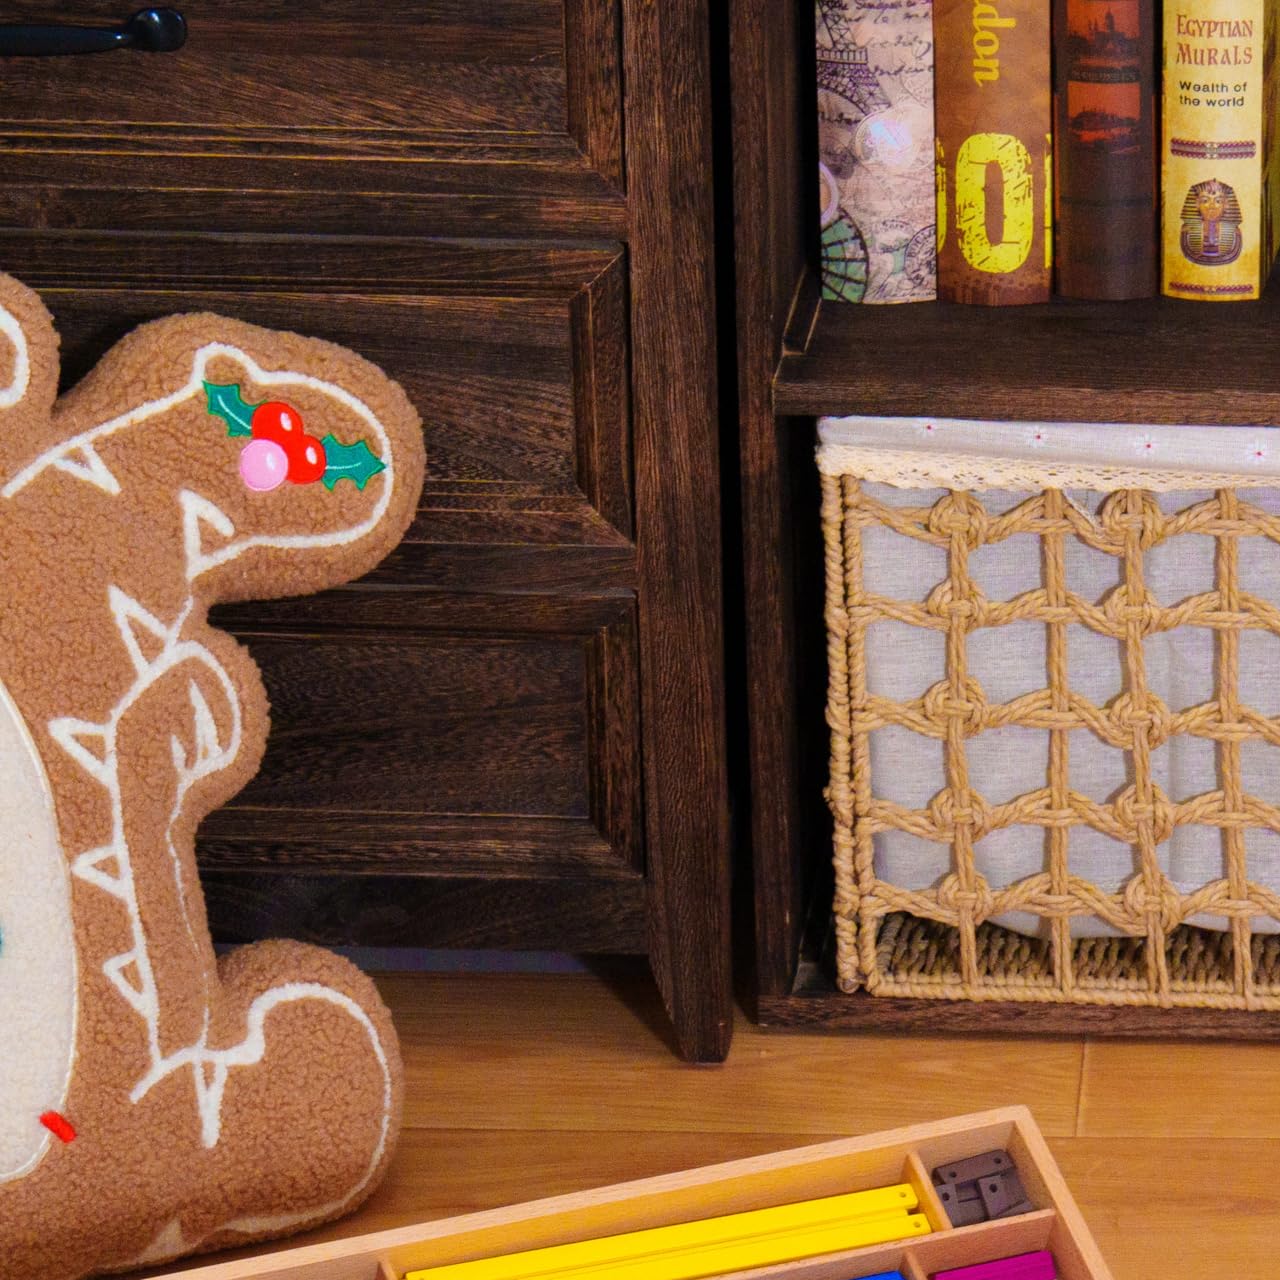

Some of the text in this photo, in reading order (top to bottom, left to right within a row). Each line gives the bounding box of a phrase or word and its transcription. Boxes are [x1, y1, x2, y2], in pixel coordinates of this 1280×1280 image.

[1176, 14, 1254, 39] EGYPTIAN
[972, 0, 1017, 87] don
[1175, 42, 1254, 66] MURALS
[1179, 80, 1248, 94] Wealth of
[1179, 94, 1245, 108] the world
